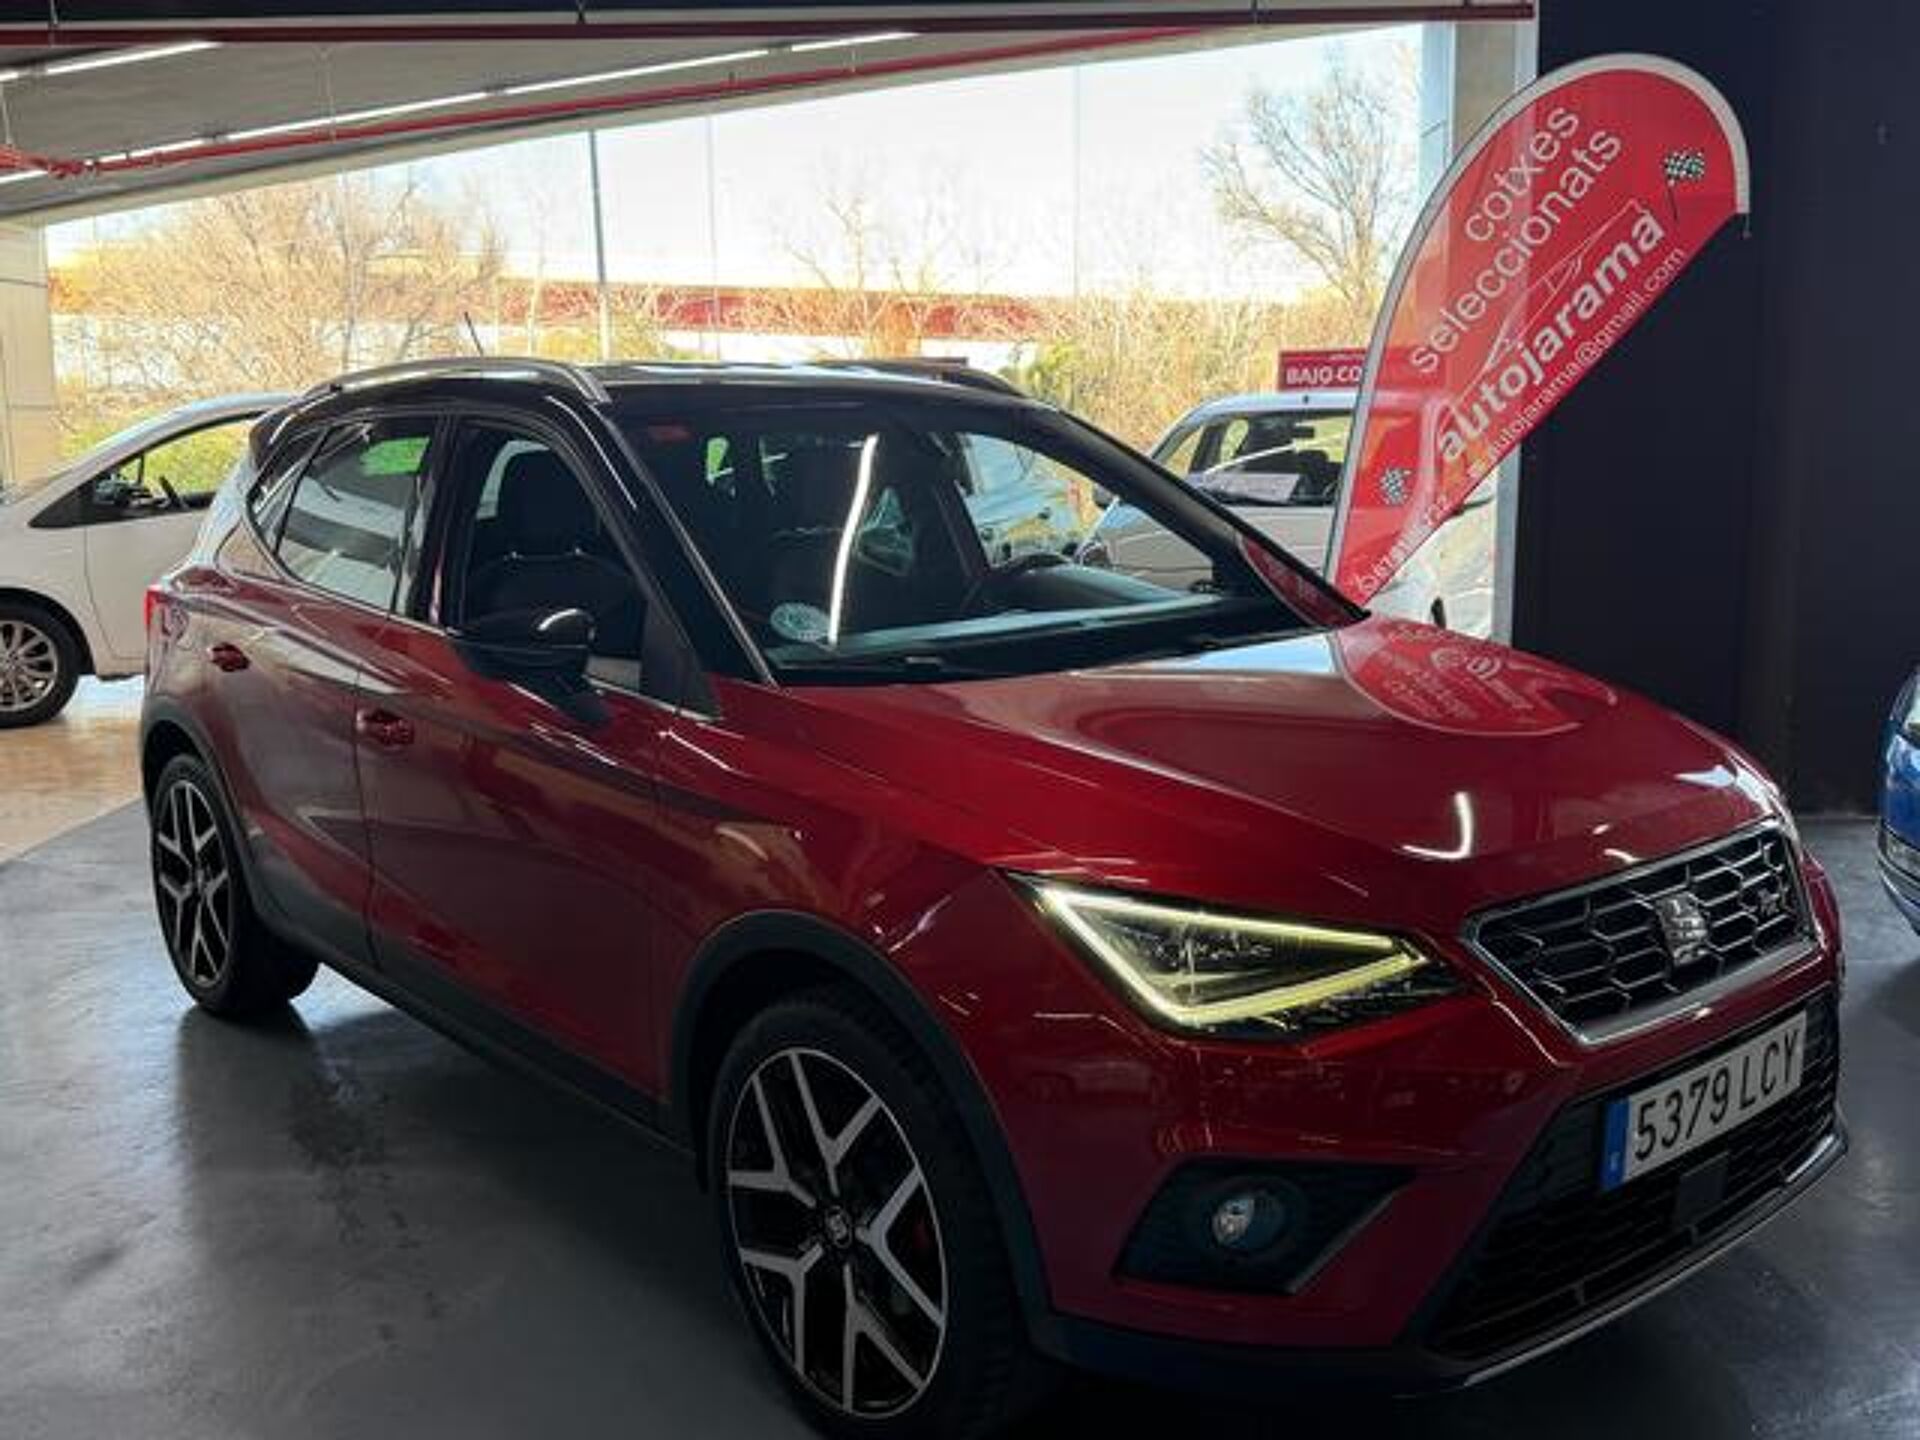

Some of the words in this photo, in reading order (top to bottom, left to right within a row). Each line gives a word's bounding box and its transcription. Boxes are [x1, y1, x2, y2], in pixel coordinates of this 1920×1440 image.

[1465, 107, 1579, 242] cotxes
[1411, 130, 1622, 373] seleccionats
[1286, 366, 1334, 385] BAJO
[1438, 209, 1666, 460] autojarama
[1635, 1066, 1729, 1161] 5379
[1738, 1029, 1799, 1110] LCY
